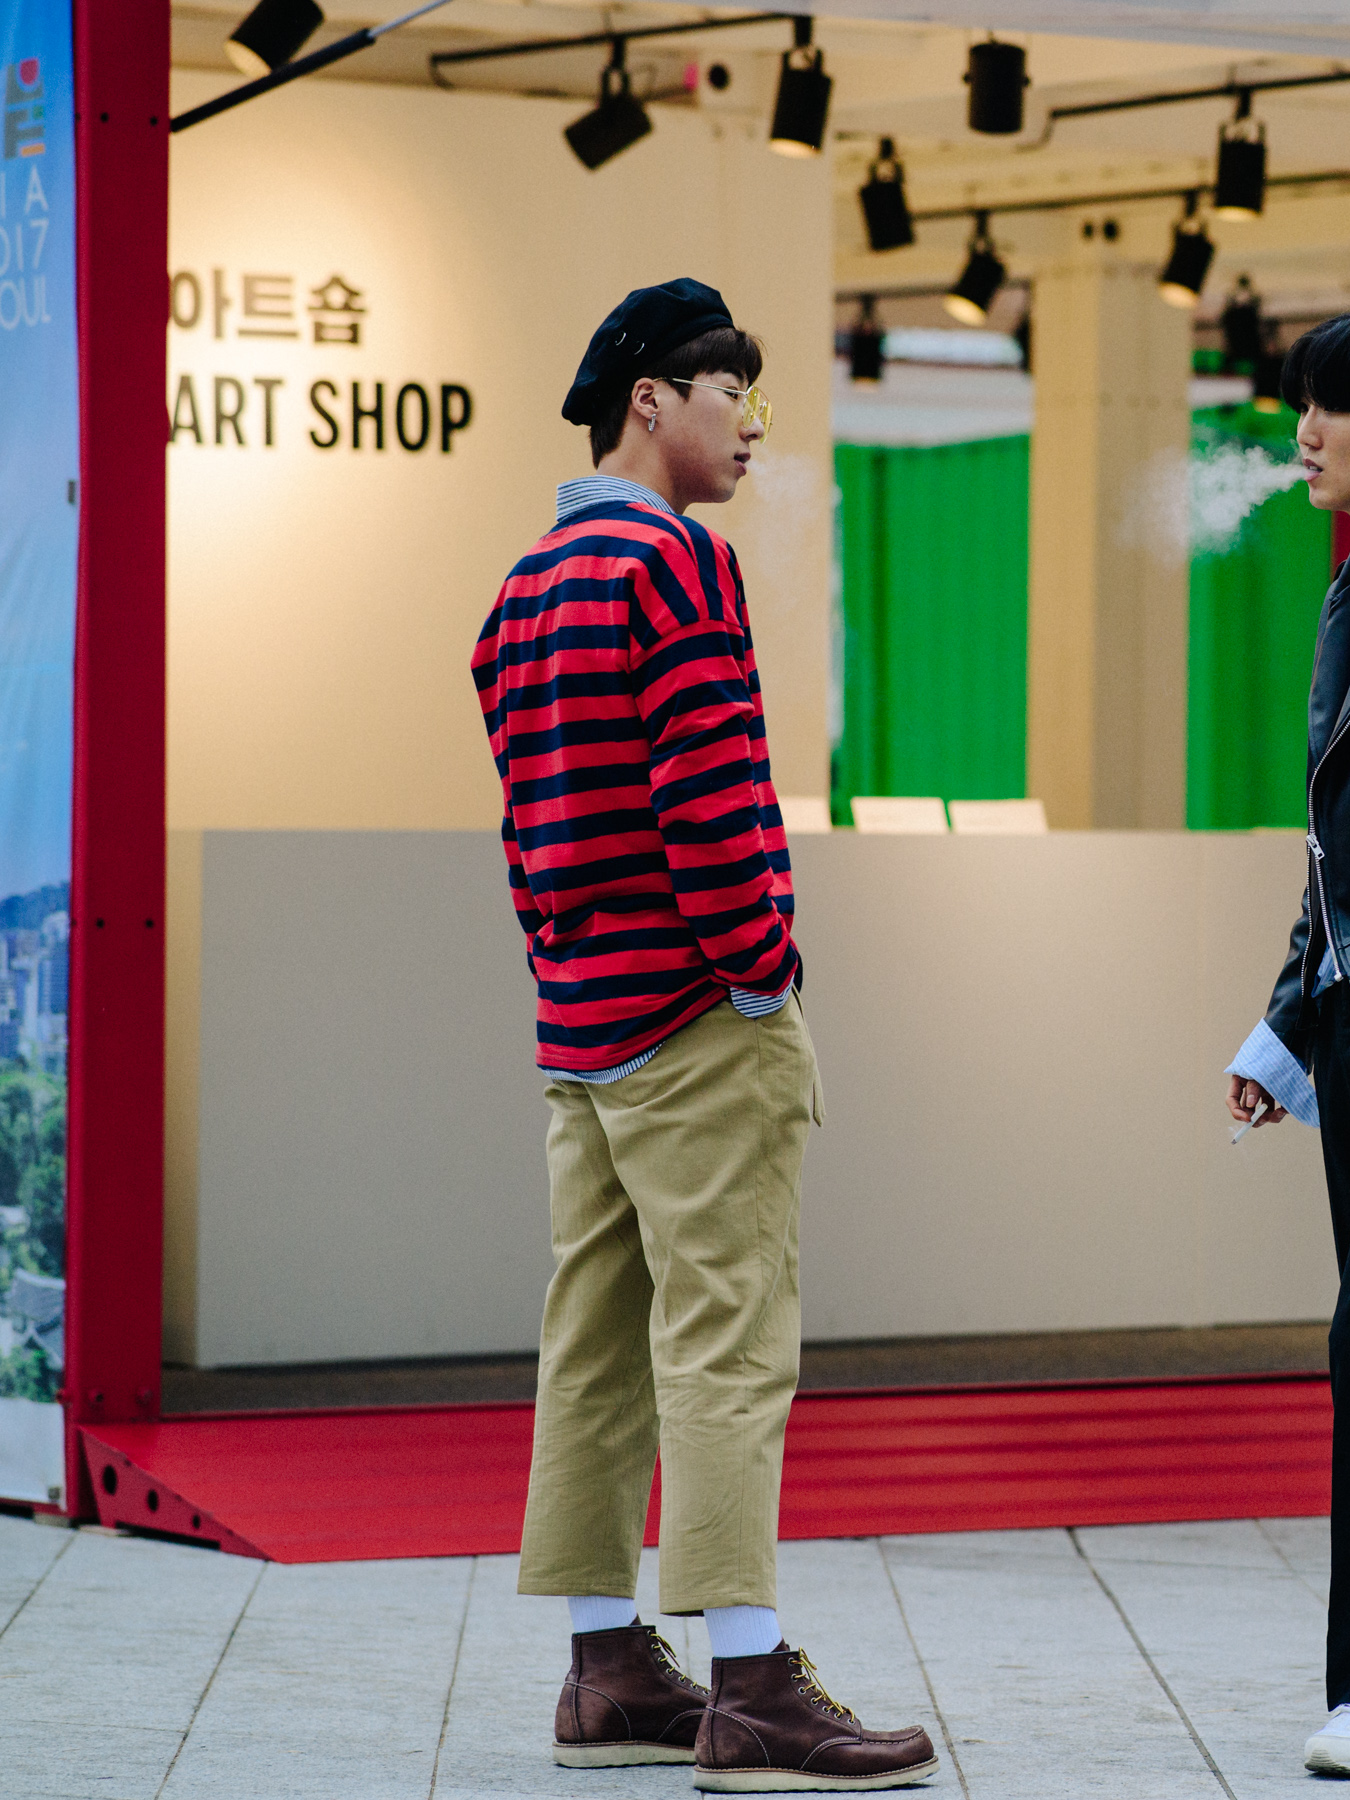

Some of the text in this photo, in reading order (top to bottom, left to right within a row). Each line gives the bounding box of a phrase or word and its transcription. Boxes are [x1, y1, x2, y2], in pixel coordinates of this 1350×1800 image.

[170, 268, 367, 345] 아트숍
[169, 375, 472, 452] ART SHOP
